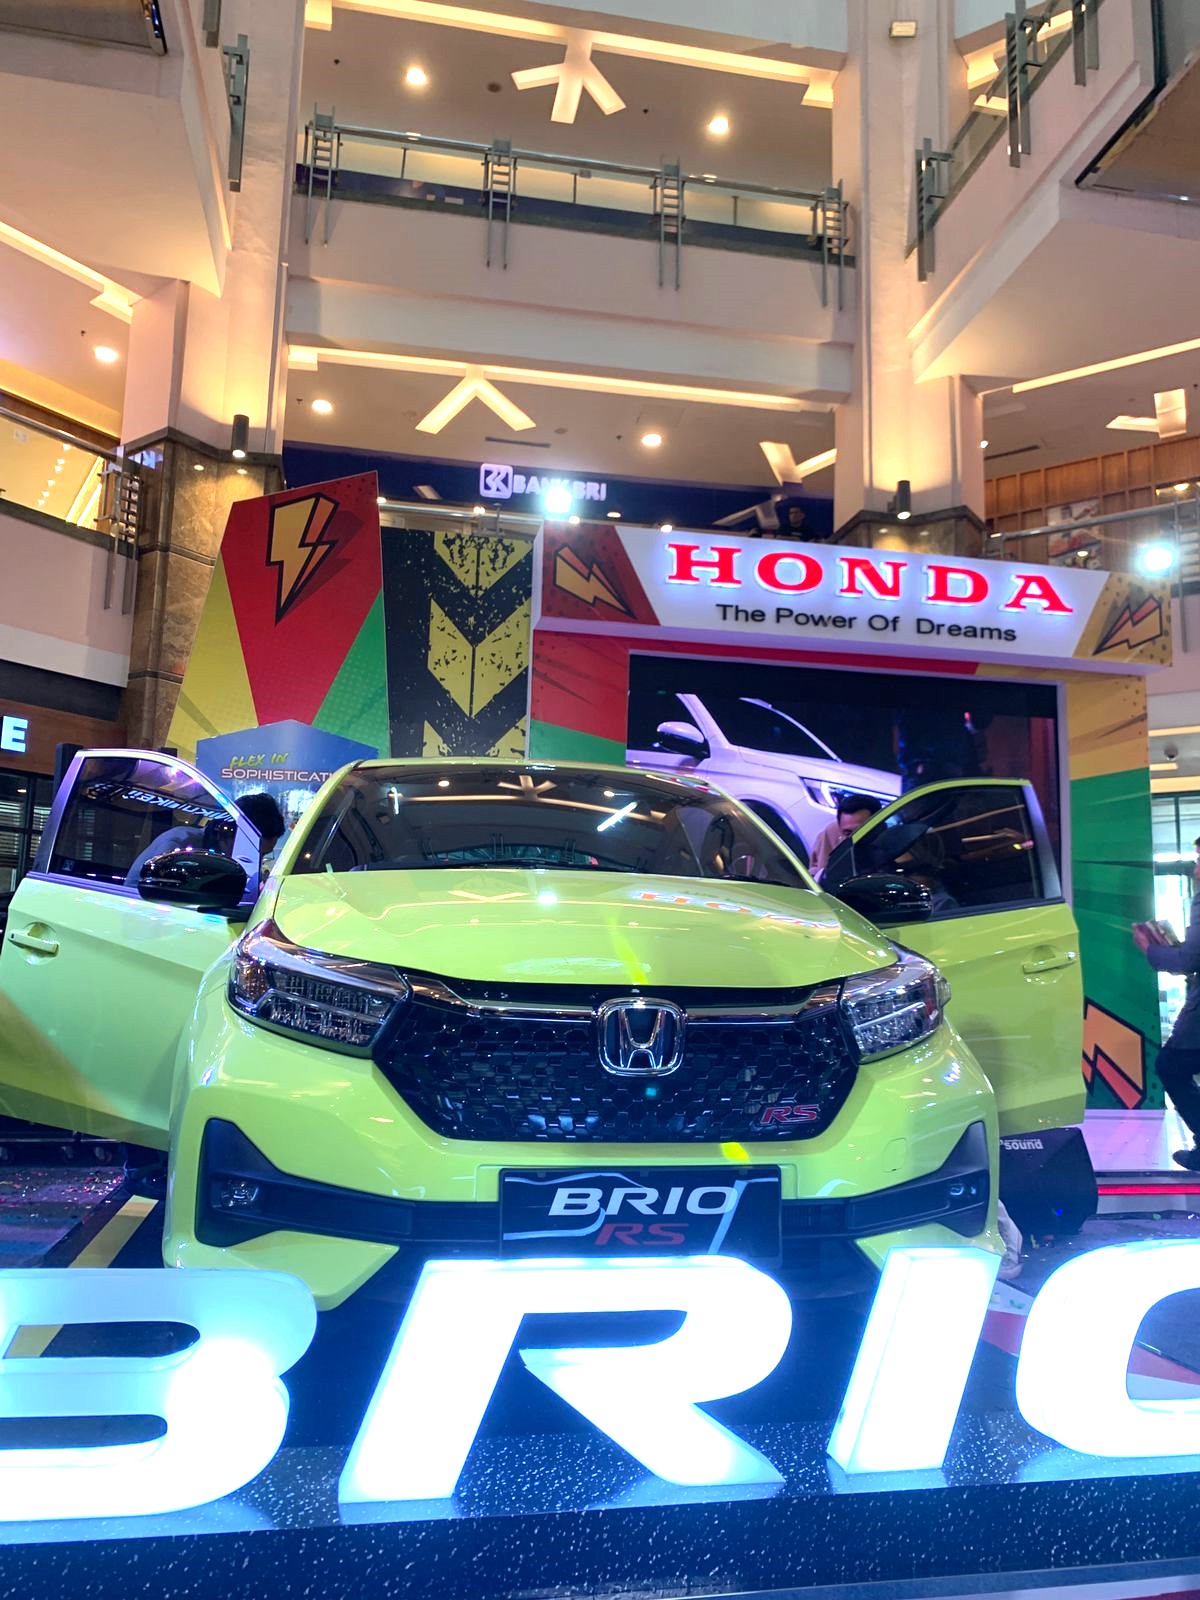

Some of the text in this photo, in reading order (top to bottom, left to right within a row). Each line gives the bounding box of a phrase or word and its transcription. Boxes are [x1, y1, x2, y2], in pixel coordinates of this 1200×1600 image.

[573, 481, 607, 501] BRI
[667, 543, 1074, 614] HONDA
[716, 604, 1017, 641] The Power Of Dreams
[230, 753, 288, 768] FLEX IN
[760, 1104, 819, 1124] RS
[548, 1186, 738, 1216] BRIO
[594, 1223, 689, 1246] RS
